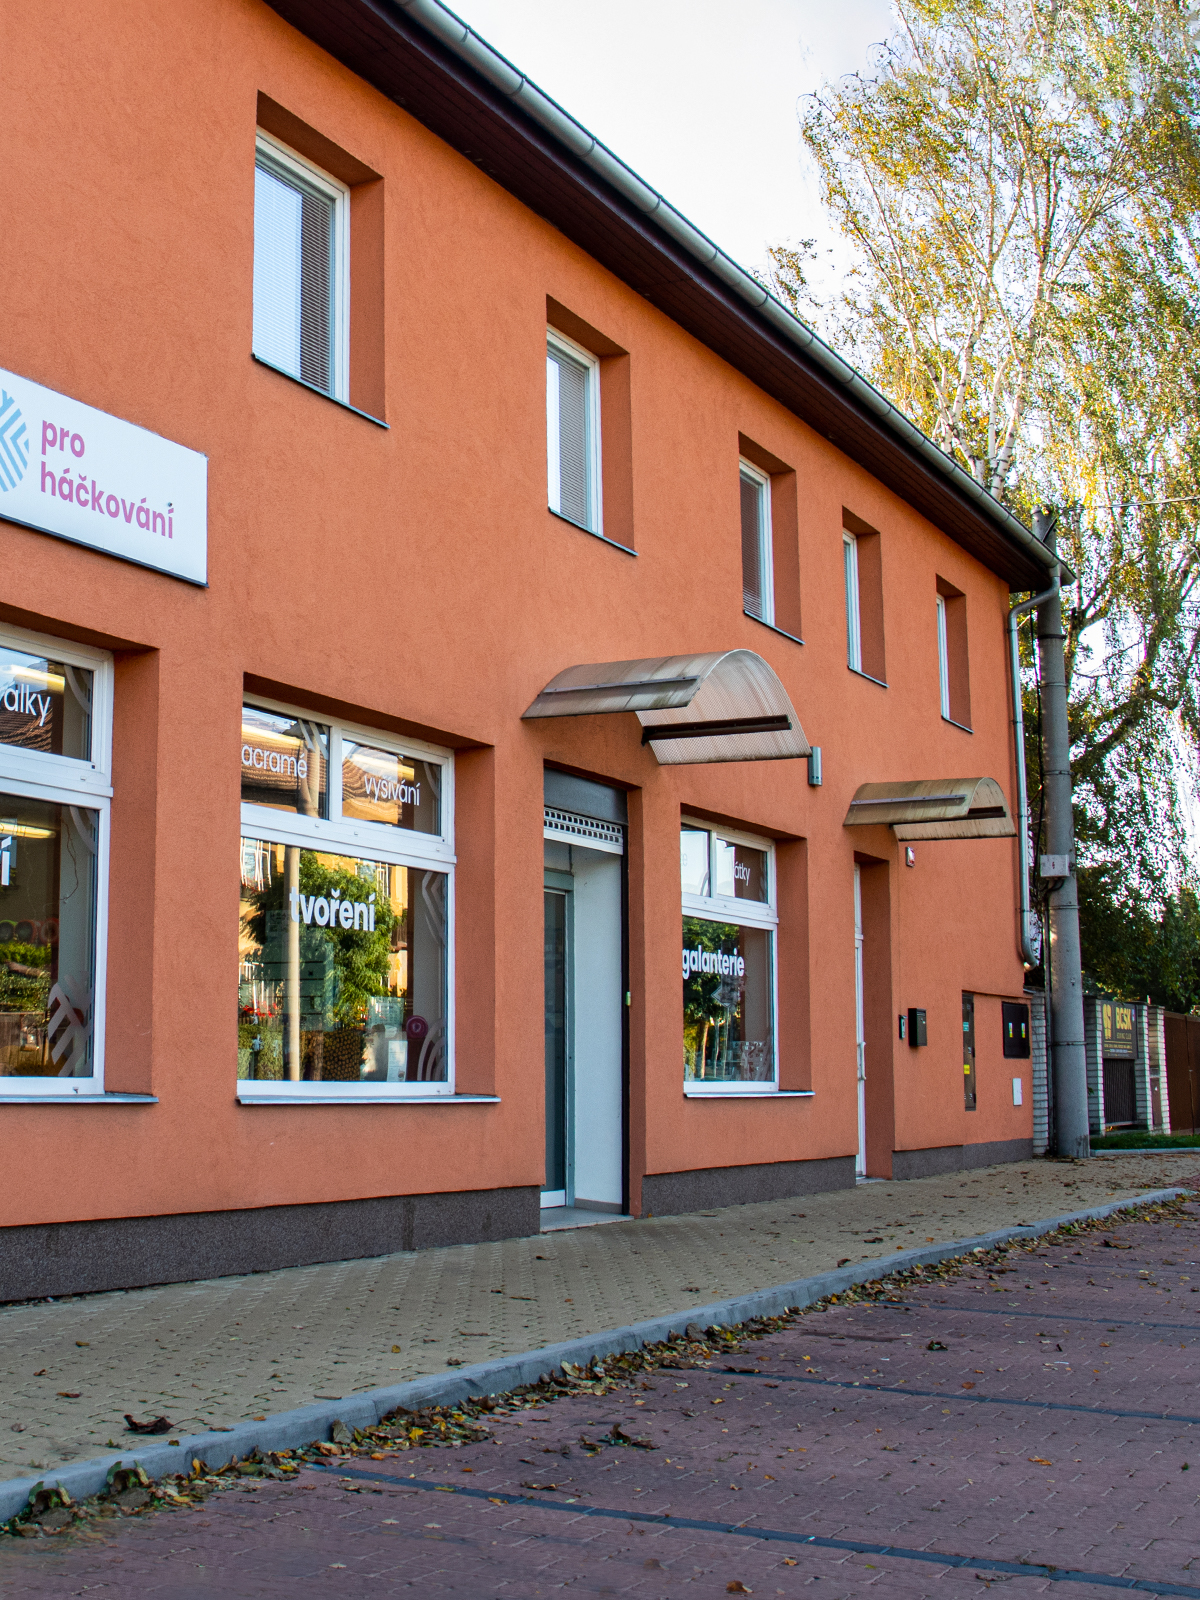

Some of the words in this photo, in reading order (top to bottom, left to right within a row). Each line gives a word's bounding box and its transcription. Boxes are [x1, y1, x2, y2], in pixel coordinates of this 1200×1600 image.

[41, 419, 85, 458] pro
[40, 460, 174, 539] háčkování
[241, 744, 308, 779] acramé
[364, 774, 421, 806] vyšívání
[289, 886, 376, 932] tvoření
[681, 944, 745, 980] galanterie
